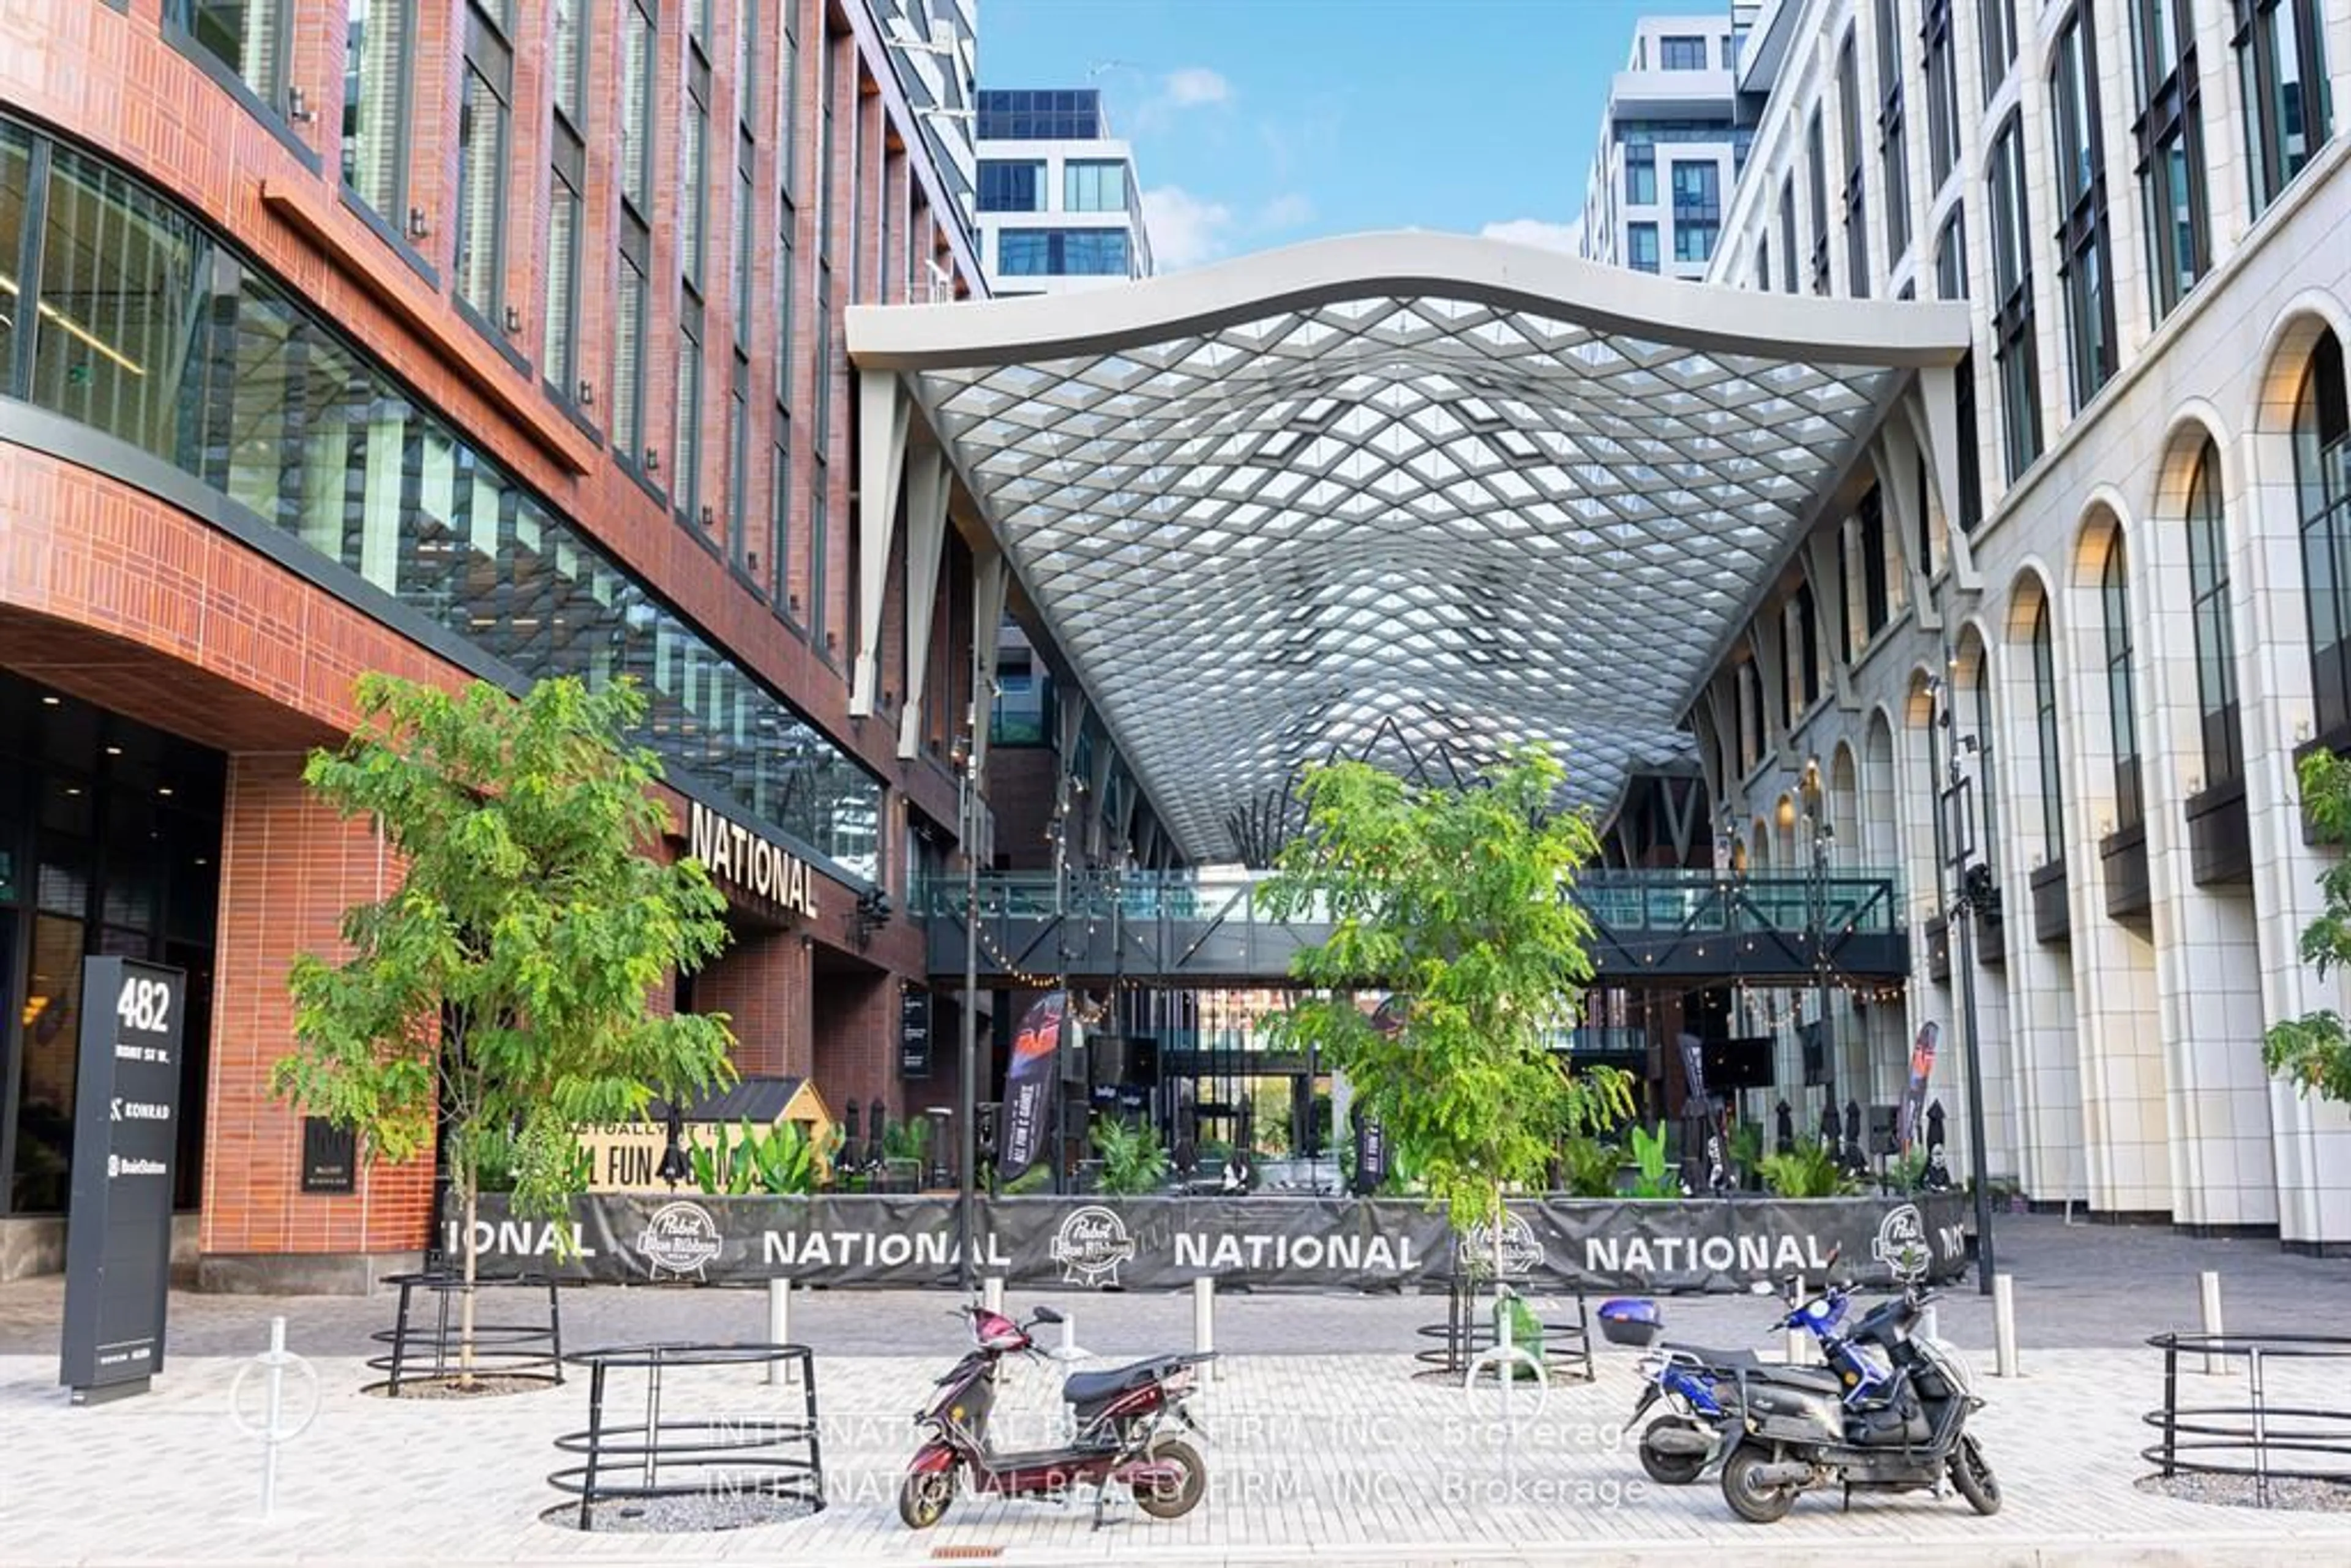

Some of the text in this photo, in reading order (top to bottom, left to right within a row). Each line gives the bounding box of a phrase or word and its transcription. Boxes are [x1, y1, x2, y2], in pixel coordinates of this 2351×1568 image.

[692, 801, 817, 919] NATIONAL
[117, 978, 169, 1032] 482
[608, 1145, 652, 1185] FUN
[441, 1220, 596, 1257] IONAL
[1175, 1232, 1422, 1270] NATIONAL
[1585, 1233, 1829, 1271] NATIONAL
